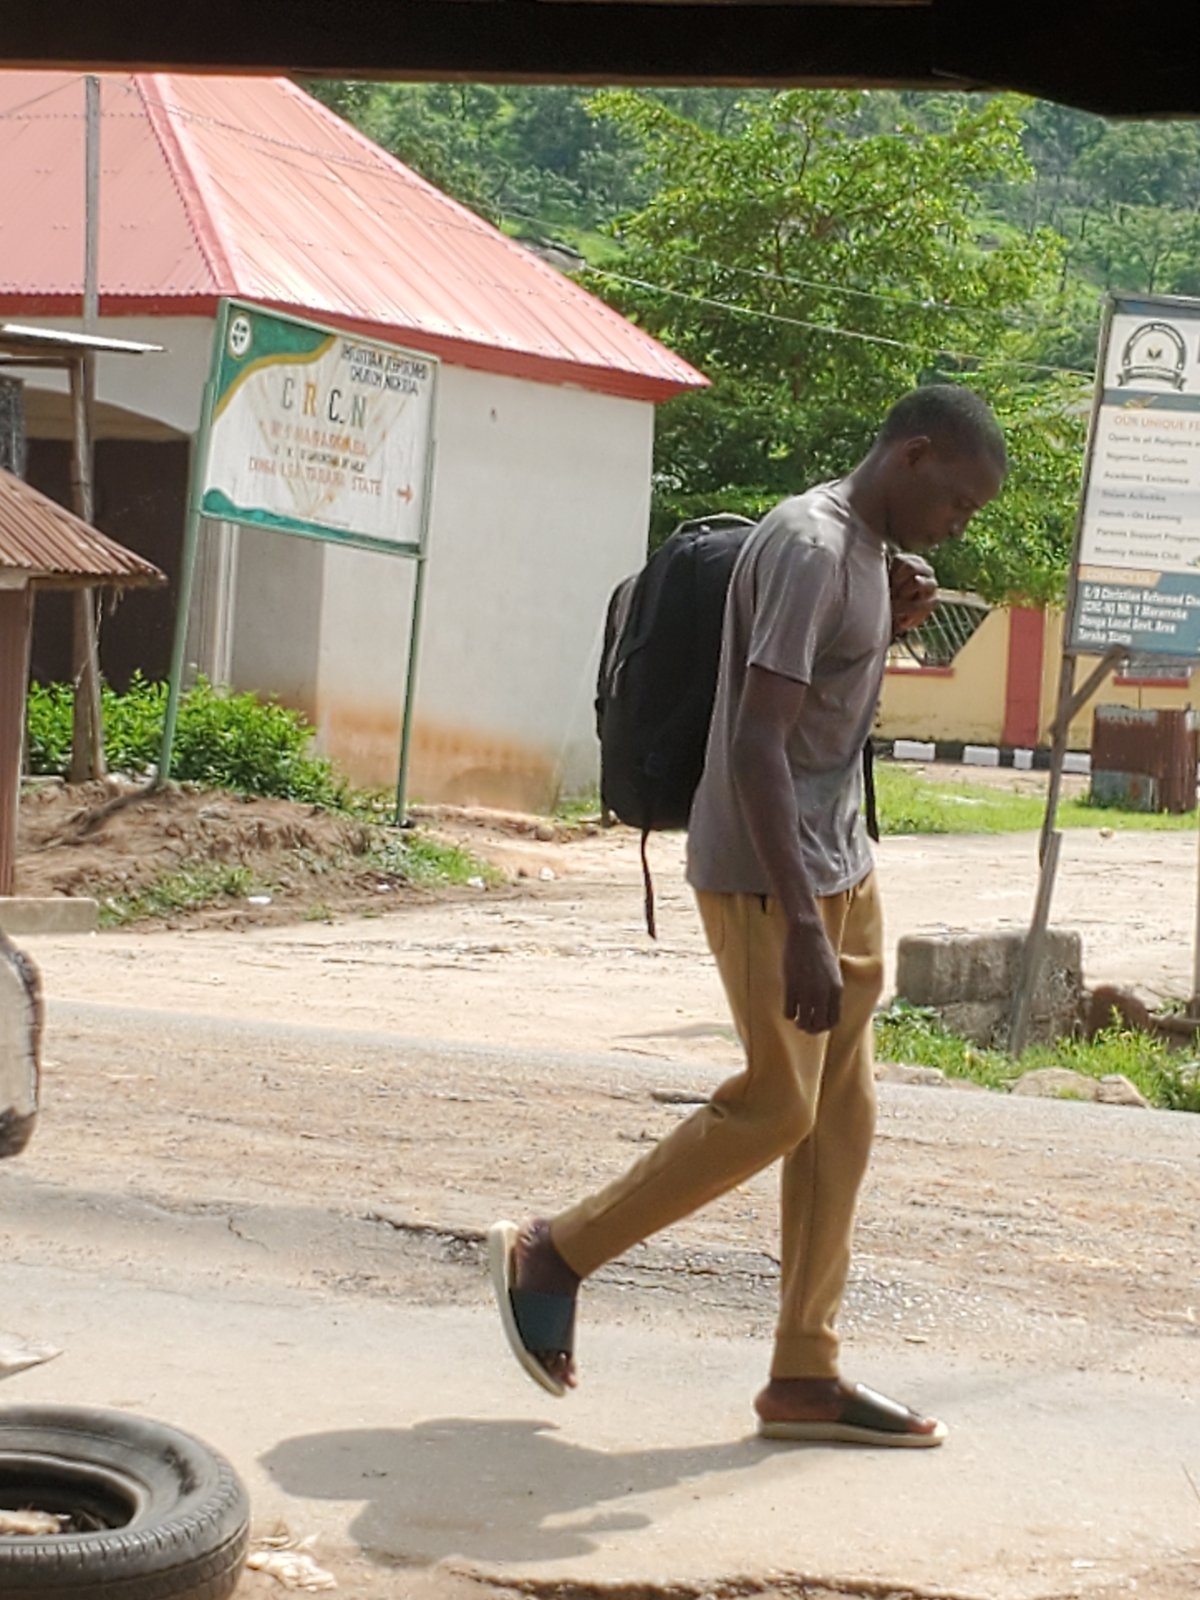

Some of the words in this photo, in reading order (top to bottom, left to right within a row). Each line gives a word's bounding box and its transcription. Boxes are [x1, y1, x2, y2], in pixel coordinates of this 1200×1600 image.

[1115, 415, 1138, 428] OUR
[1141, 418, 1185, 432] UNIQUE
[1108, 432, 1131, 444] Open
[1142, 453, 1188, 465] Curriculum
[351, 475, 383, 496] STATE
[1146, 473, 1189, 485] Excellence
[1146, 511, 1182, 524] Learning
[1096, 528, 1127, 537] Parents
[1129, 530, 1162, 542] Support
[1101, 586, 1141, 602] Christian
[1142, 589, 1184, 605] Reformed
[1107, 616, 1131, 629] Local
